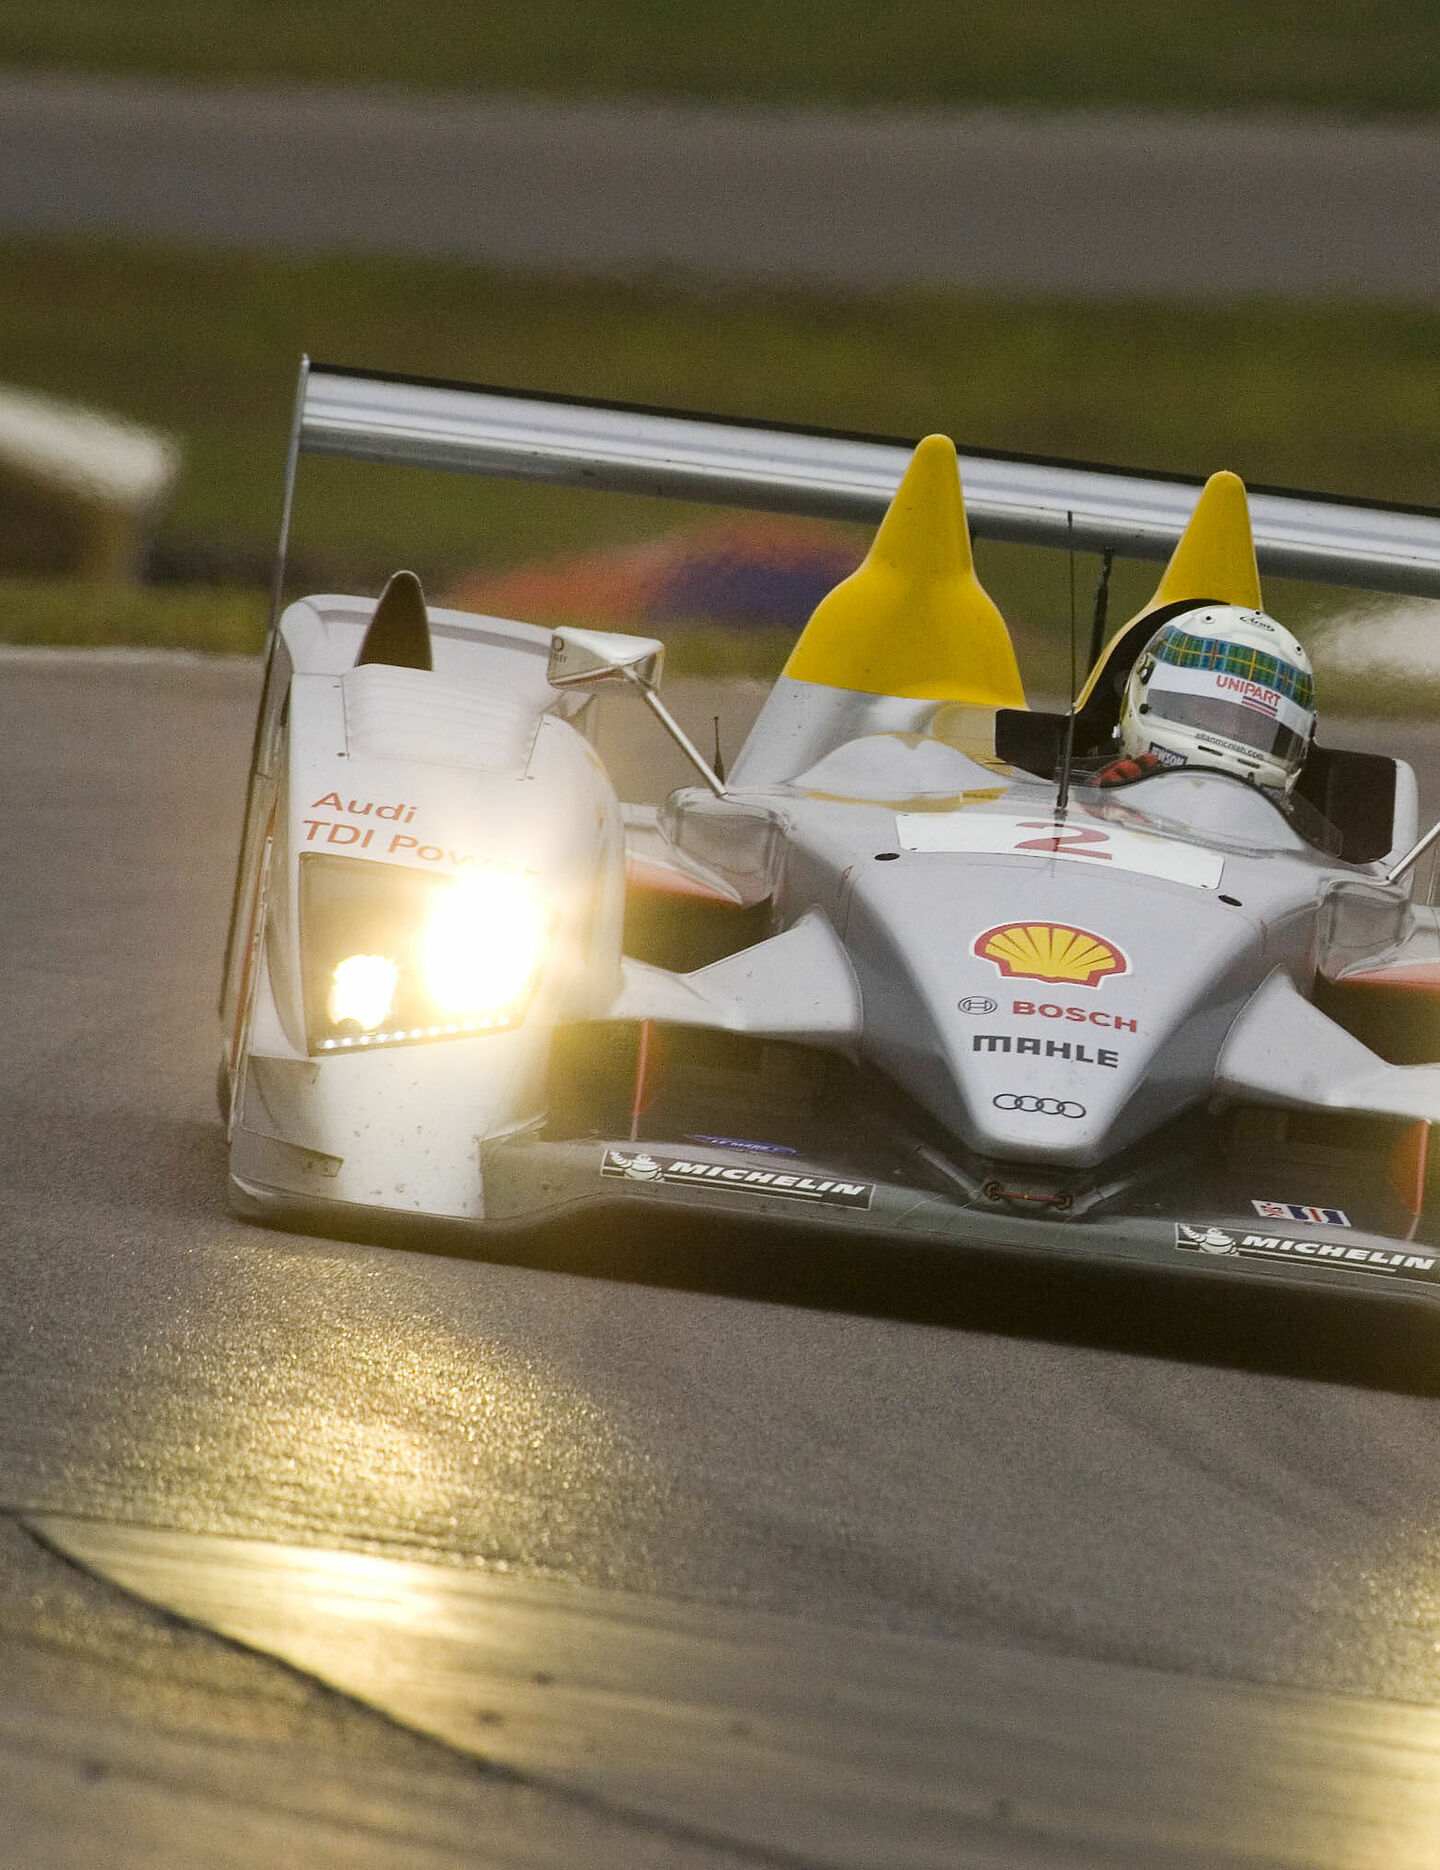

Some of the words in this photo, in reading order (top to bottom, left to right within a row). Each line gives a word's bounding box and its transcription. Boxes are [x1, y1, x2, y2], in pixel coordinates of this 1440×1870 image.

[1216, 675, 1282, 706] UNIPART
[311, 791, 418, 824] Audi
[302, 819, 376, 848] TDI
[1014, 821, 1113, 861] 2
[1012, 1000, 1138, 1033] BOSCH
[972, 1034, 1119, 1068] MAHLE
[667, 1160, 866, 1196] MICHELIN
[1241, 1235, 1437, 1270] MICHELIN
